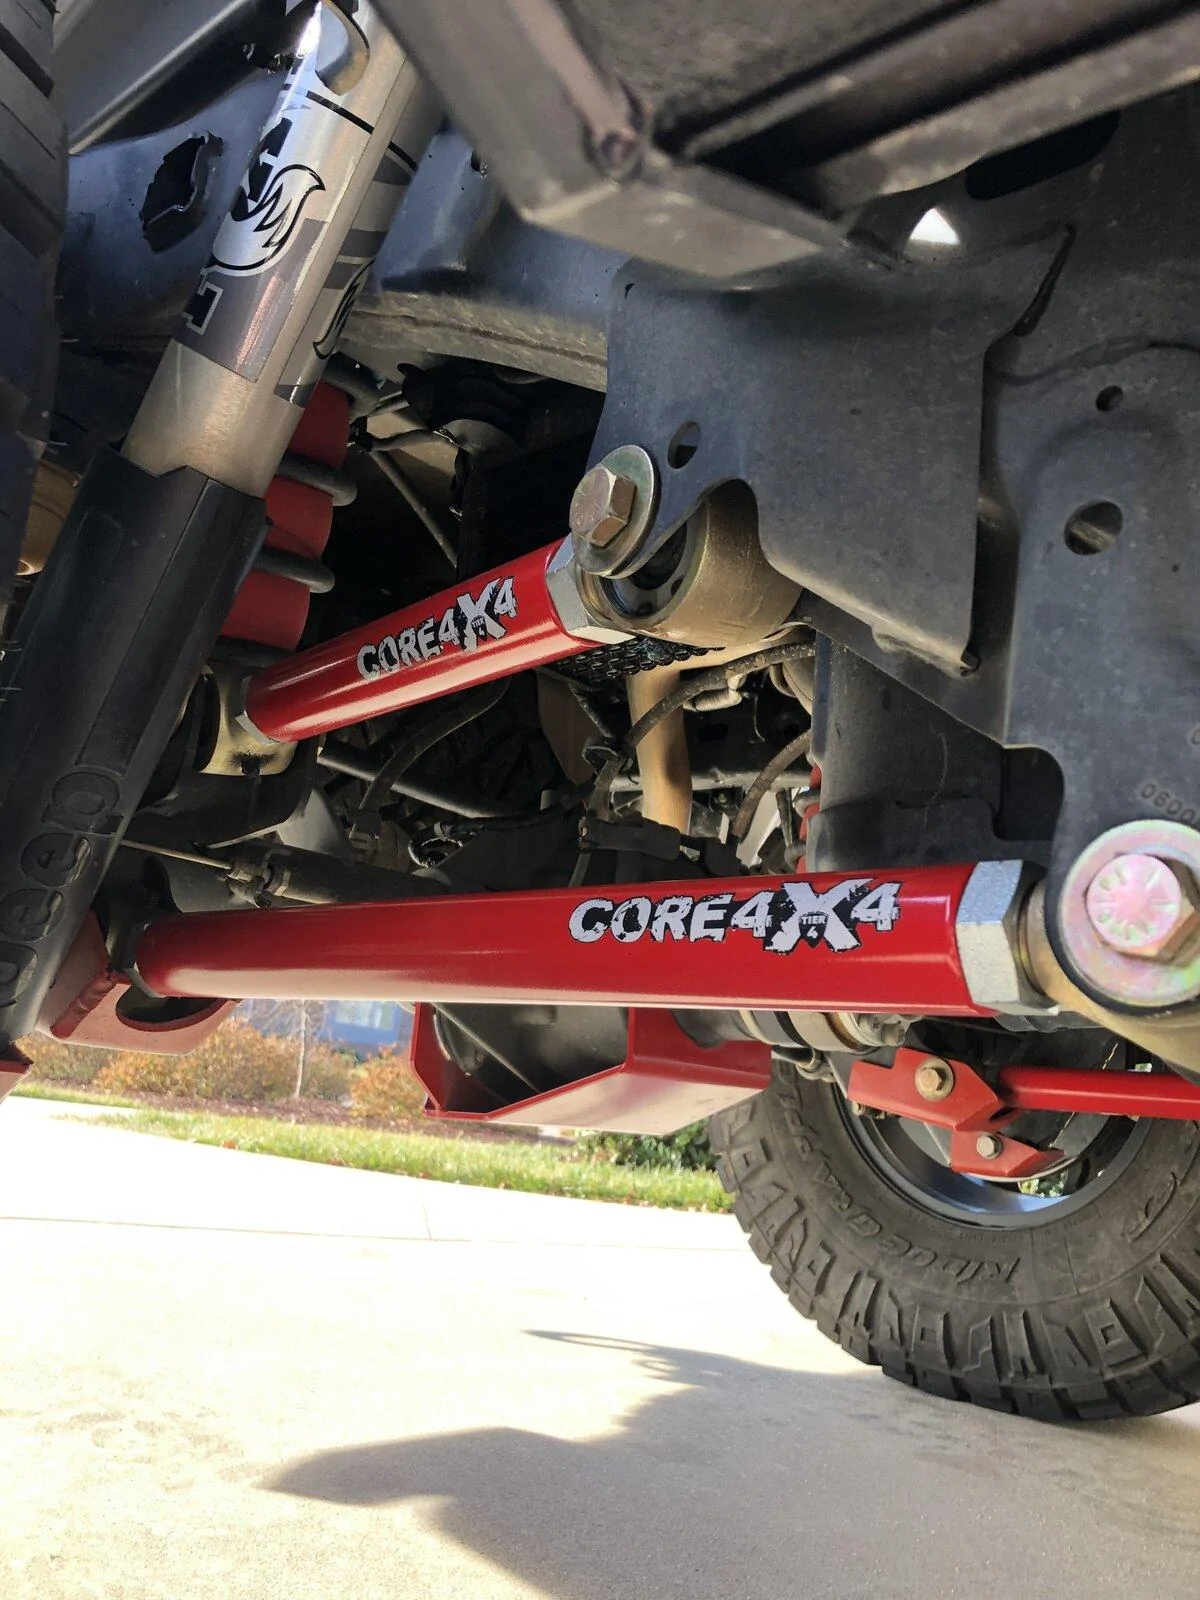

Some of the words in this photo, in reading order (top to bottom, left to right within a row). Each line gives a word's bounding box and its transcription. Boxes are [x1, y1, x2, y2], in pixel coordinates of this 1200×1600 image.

[357, 576, 518, 681] CORE4X4
[568, 878, 903, 955] CORE4X4
[801, 915, 827, 925] TIER
[806, 926, 819, 939] 4
[777, 1062, 882, 1238] GRAPPLE
